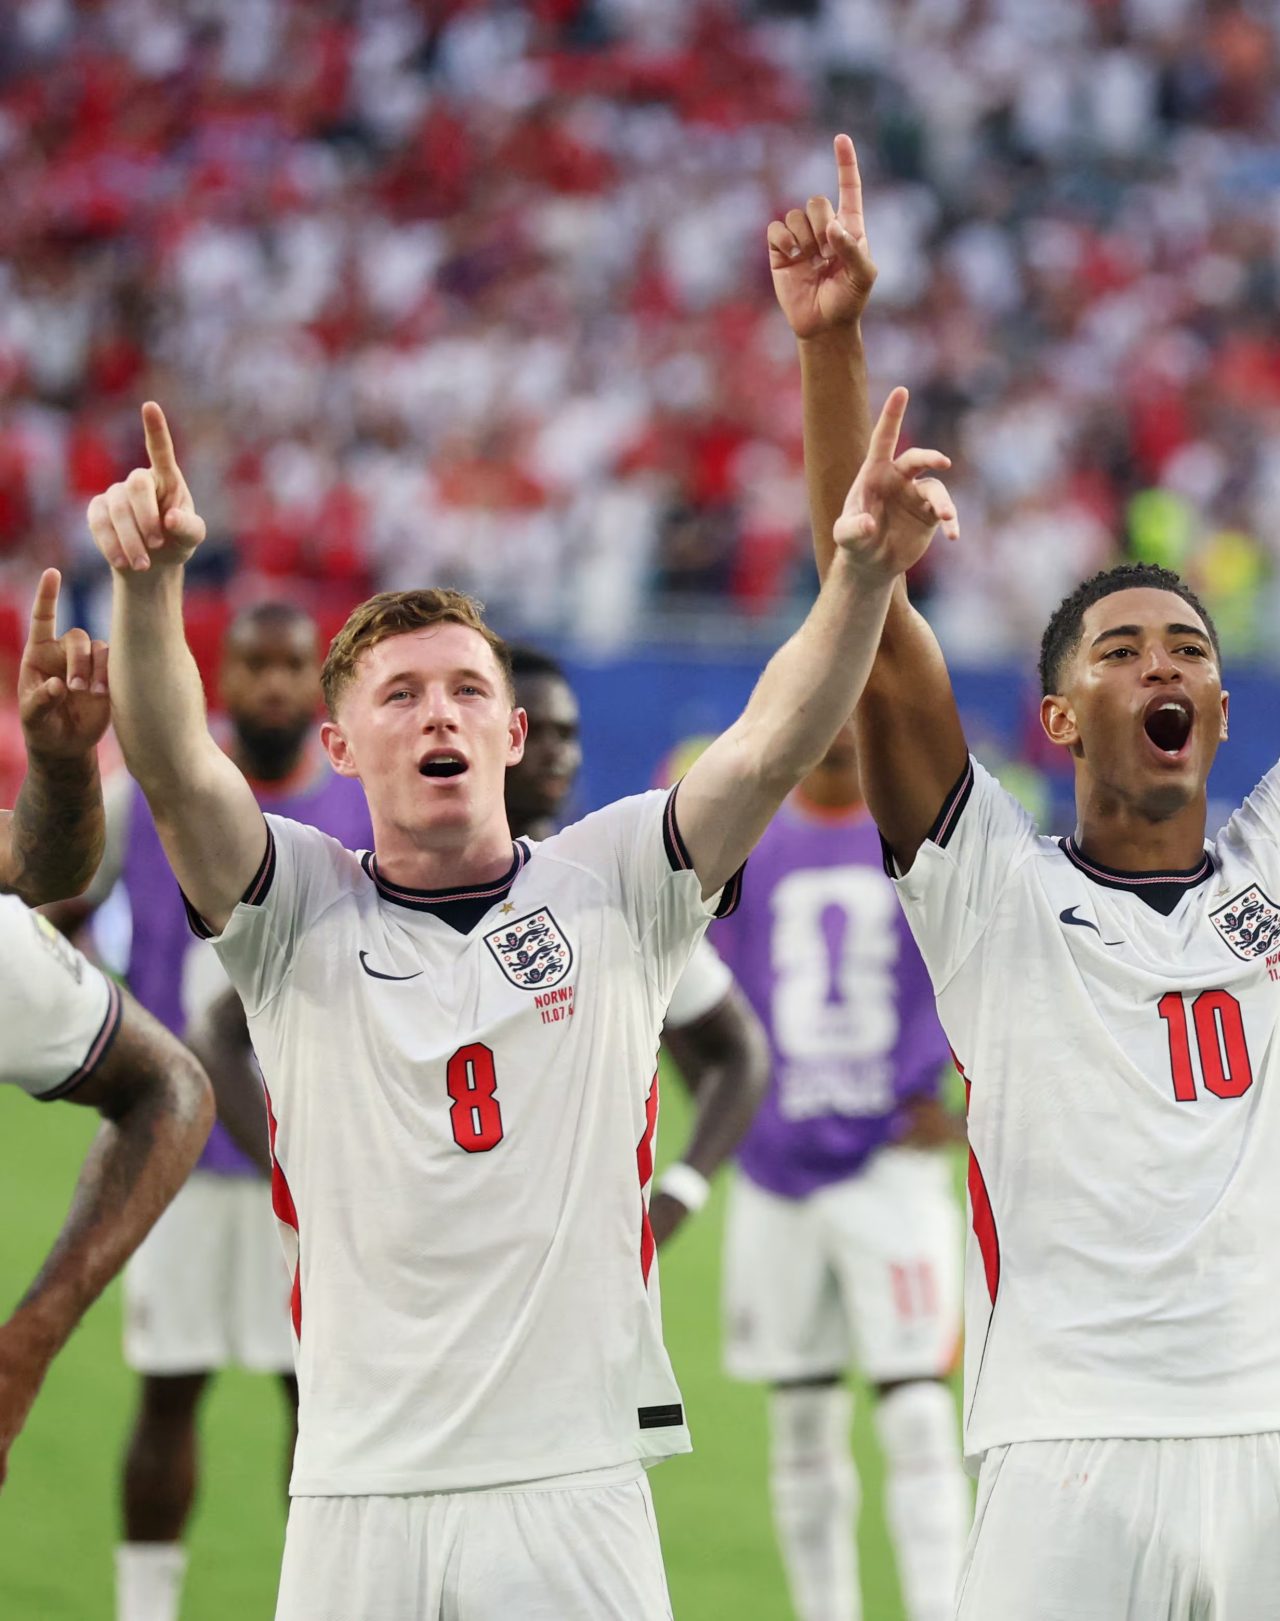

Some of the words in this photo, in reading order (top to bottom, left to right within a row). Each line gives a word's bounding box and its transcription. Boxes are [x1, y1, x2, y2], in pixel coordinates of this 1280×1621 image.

[534, 985, 575, 1009] NORWA
[1157, 989, 1253, 1102] 10
[447, 1042, 504, 1153] 8
